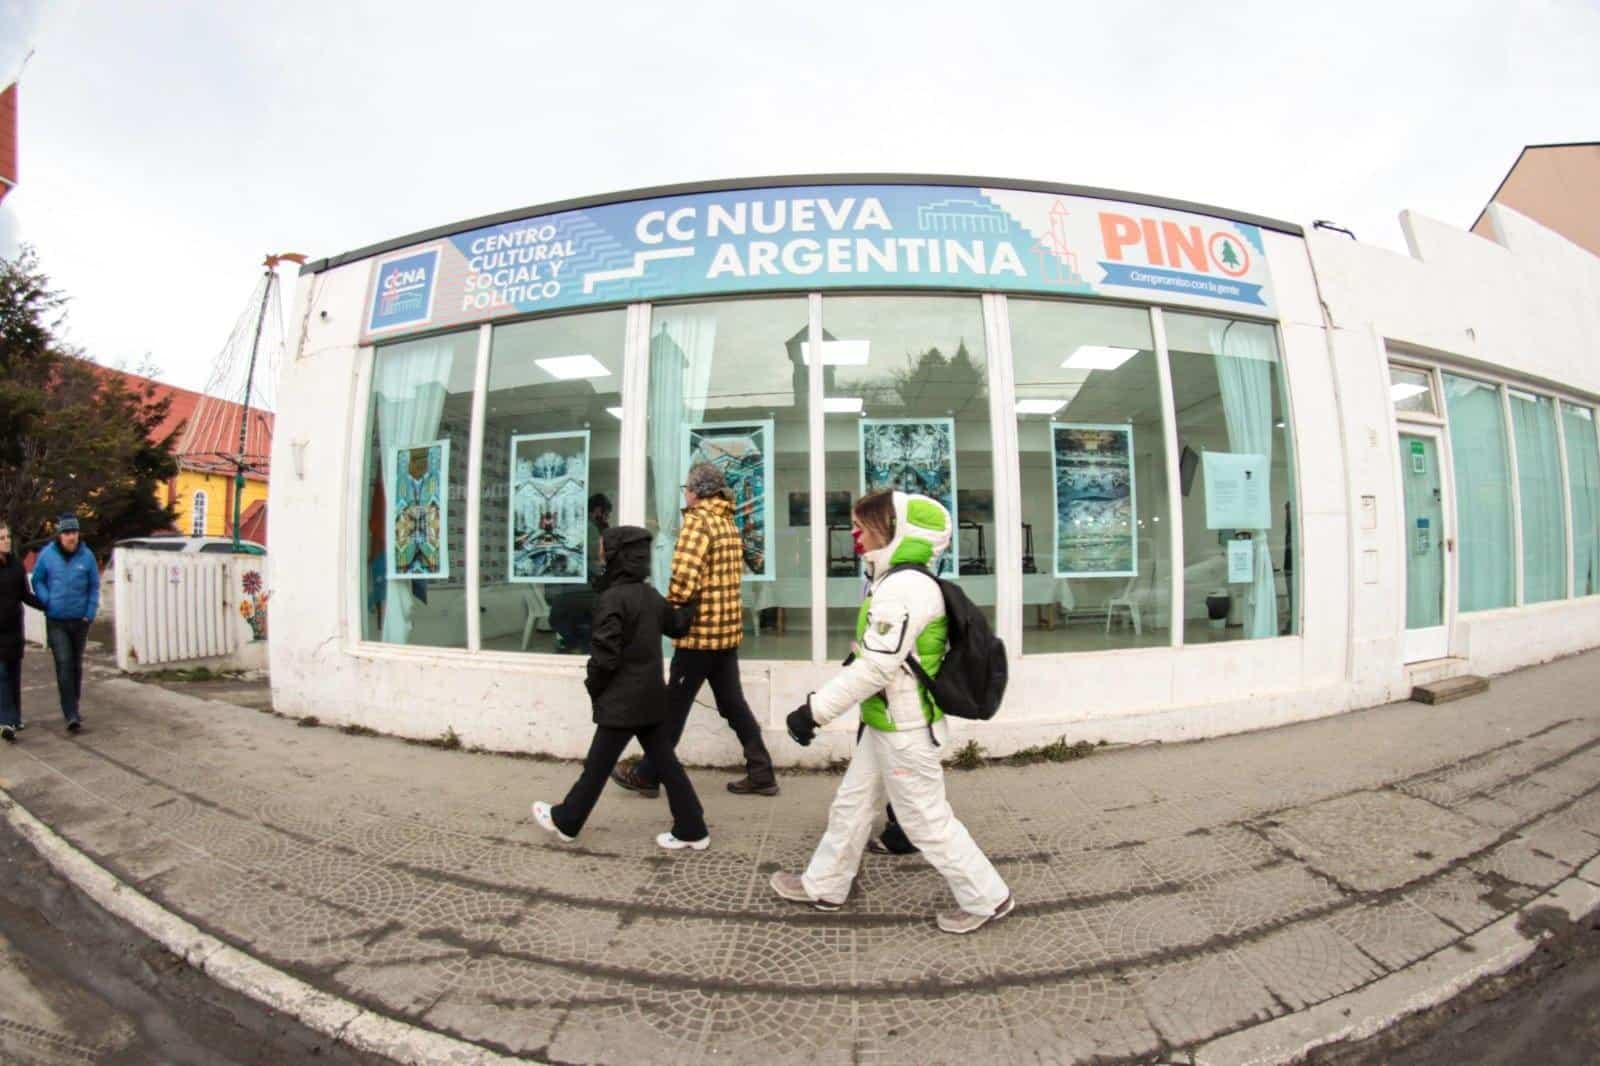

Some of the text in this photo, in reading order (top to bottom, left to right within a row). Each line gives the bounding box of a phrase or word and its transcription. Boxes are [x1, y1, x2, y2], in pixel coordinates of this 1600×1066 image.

[634, 207, 697, 245] CC
[707, 197, 893, 237] NUEVA
[470, 239, 577, 271] CULTURAL
[471, 225, 556, 255] CENTRO
[1098, 213, 1250, 277] PINO
[464, 259, 563, 292] SOCIAL Y
[706, 237, 1028, 279] ARGENTINA
[384, 268, 426, 288] CCNA
